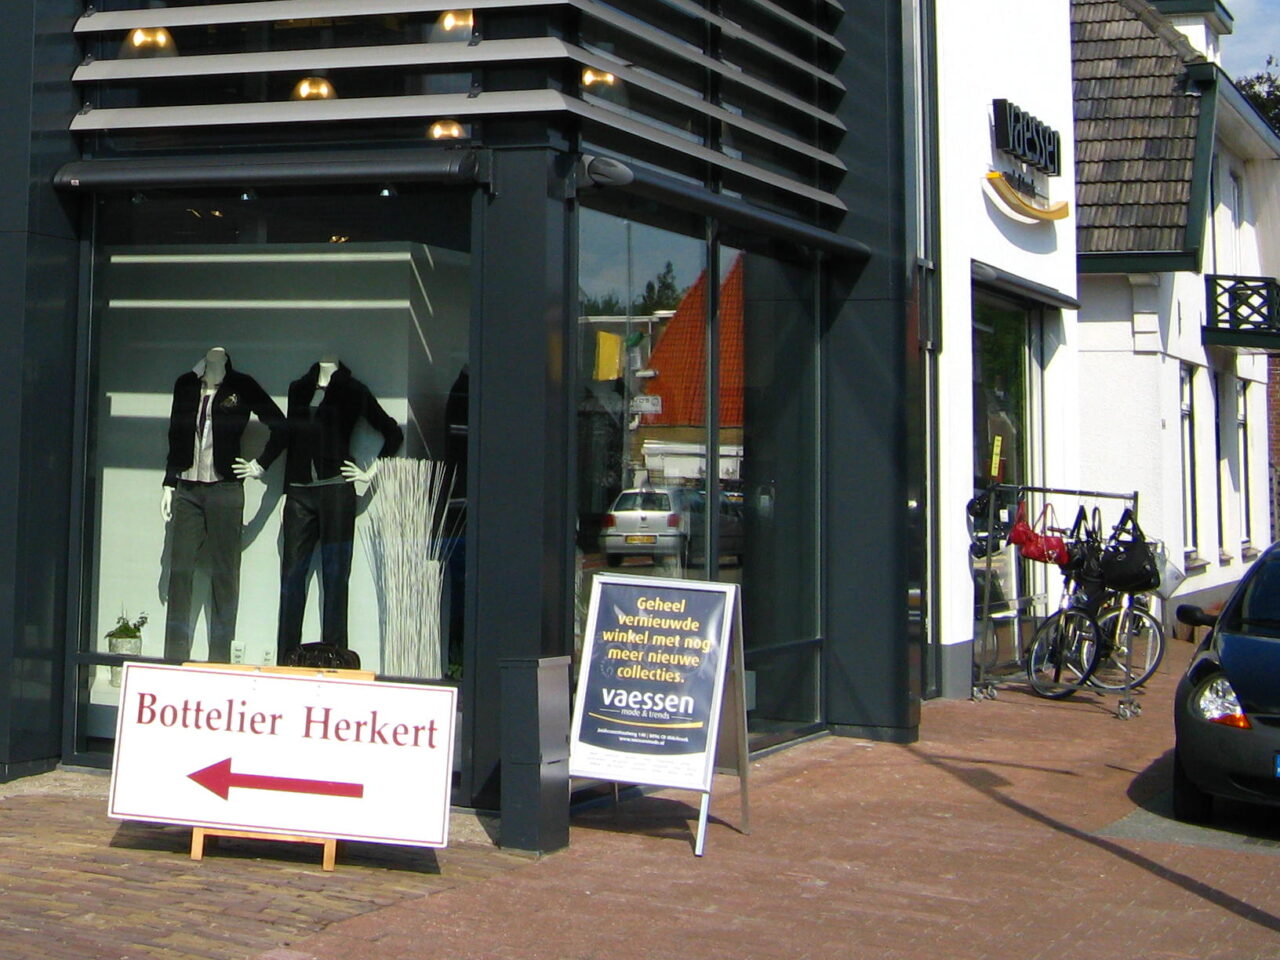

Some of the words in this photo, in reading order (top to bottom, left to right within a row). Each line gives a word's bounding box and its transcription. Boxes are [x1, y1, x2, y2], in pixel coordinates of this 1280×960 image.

[637, 596, 686, 613] Geheel
[618, 614, 700, 632] vernieuwde
[602, 629, 648, 644] winkel
[652, 634, 680, 647] met
[684, 637, 712, 653] nog
[607, 647, 644, 661] meer
[647, 650, 700, 666] nieuwe
[617, 665, 685, 683] collecties.
[602, 688, 695, 714] vaessen
[136, 692, 282, 736] Bottelier
[302, 706, 438, 749] Herkert
[621, 708, 640, 717] mode
[641, 709, 648, 718] &
[649, 710, 670, 720] trends
